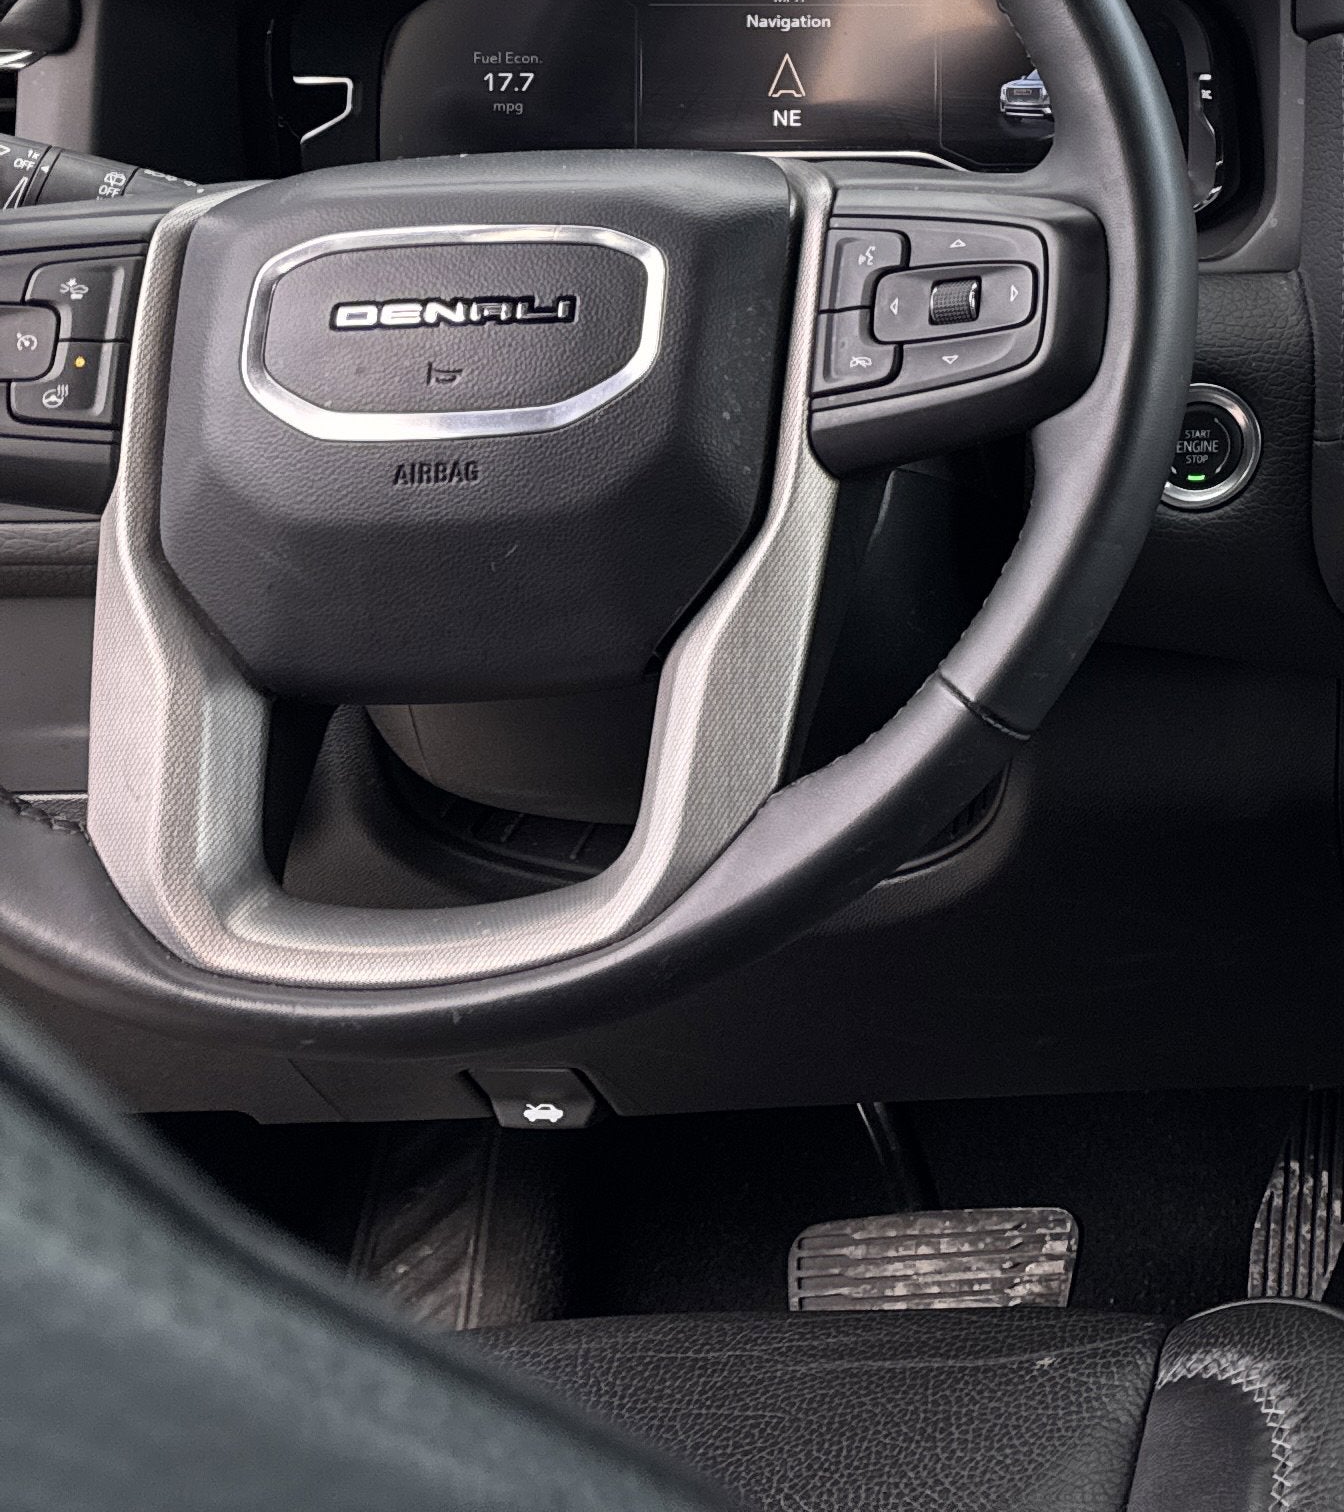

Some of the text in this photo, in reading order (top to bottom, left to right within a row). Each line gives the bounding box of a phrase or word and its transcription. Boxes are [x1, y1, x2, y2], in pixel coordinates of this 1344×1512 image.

[746, 14, 832, 31] Navigation
[473, 51, 543, 64] Fuel Econ.
[483, 72, 535, 92] 17.7
[493, 102, 524, 115] mpg
[773, 109, 802, 127] NE
[13, 159, 35, 170] OFF
[98, 185, 120, 196] OFF
[329, 295, 578, 331] DENALI
[1185, 429, 1211, 439] START
[1176, 439, 1219, 454] ENGINE
[1185, 454, 1209, 464] STOP
[393, 461, 480, 486] AIRBAG
